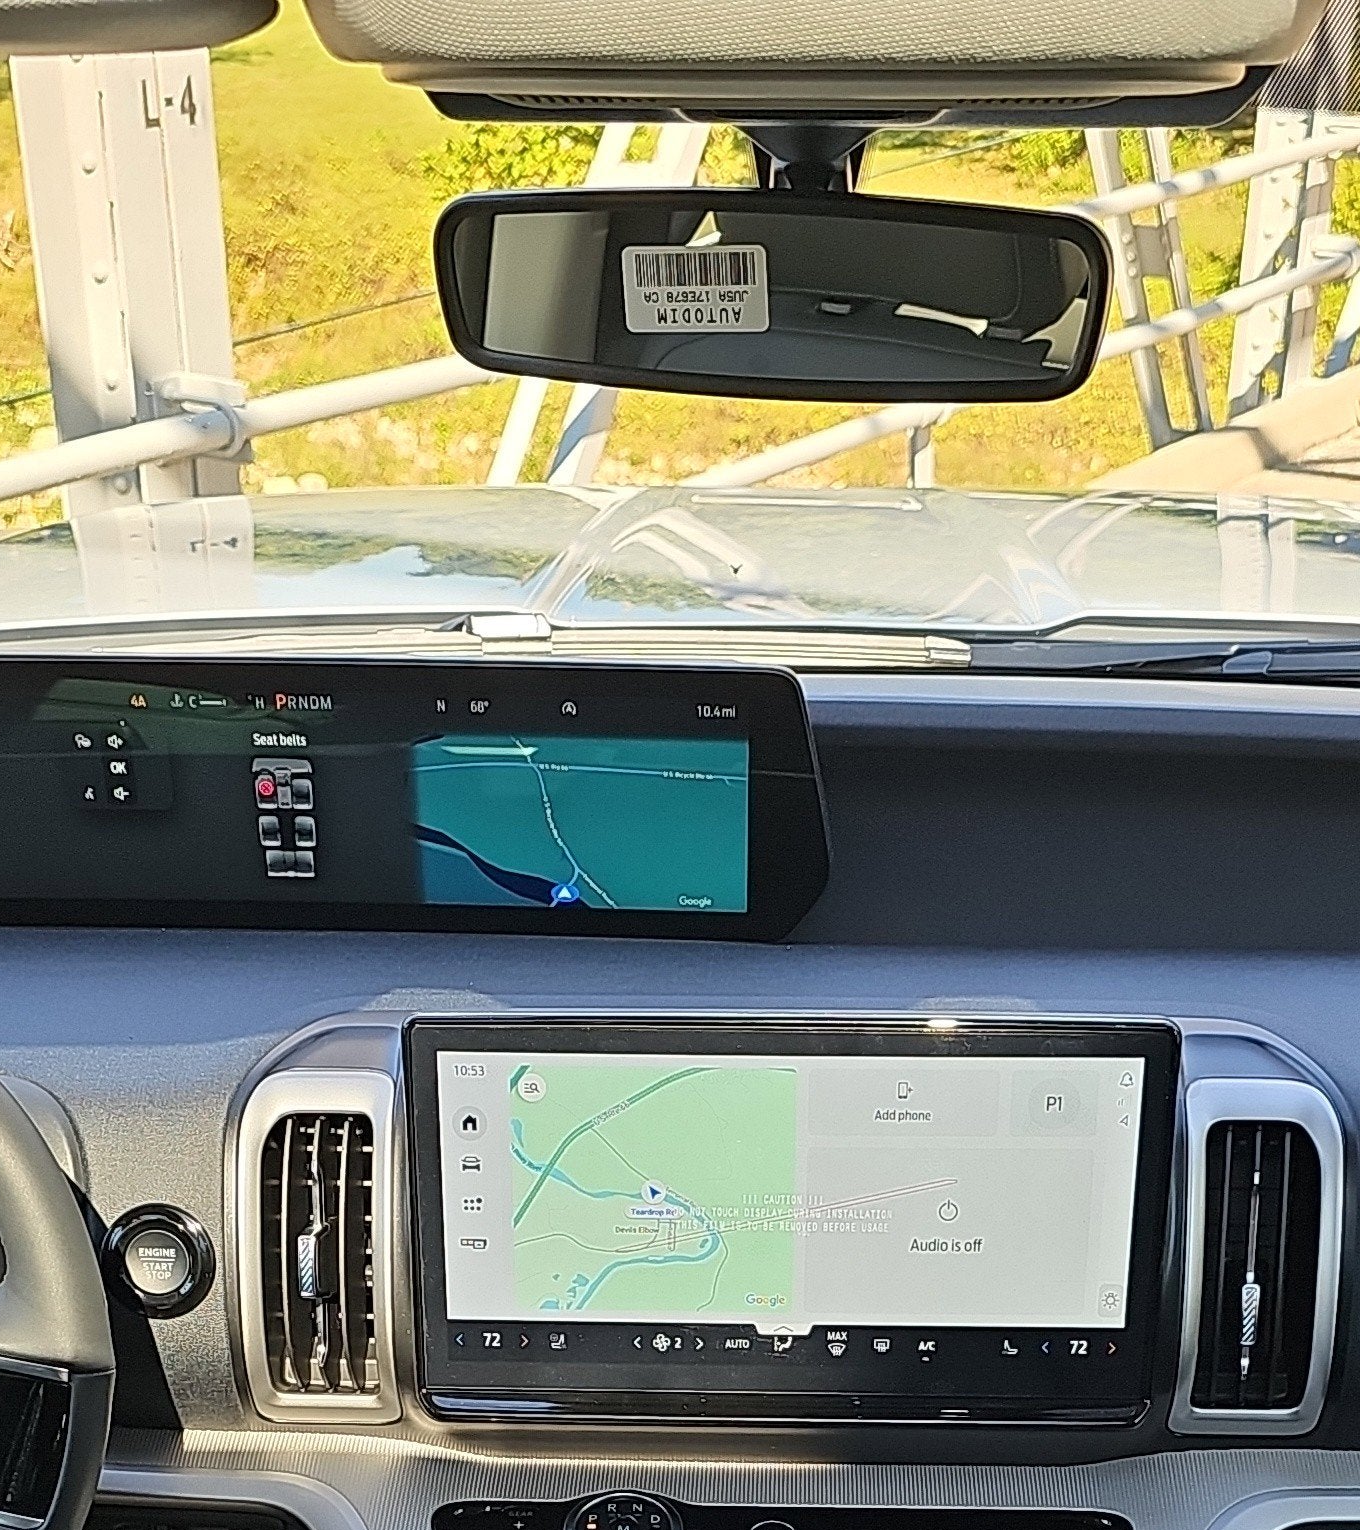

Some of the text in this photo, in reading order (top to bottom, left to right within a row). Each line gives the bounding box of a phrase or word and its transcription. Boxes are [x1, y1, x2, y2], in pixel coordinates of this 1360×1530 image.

[141, 74, 197, 129] L-4
[643, 292, 660, 304] CA
[666, 291, 710, 303] 17E678
[656, 306, 742, 325] AUTODIM
[436, 699, 446, 712] N
[252, 732, 307, 747] Seat belts
[109, 761, 128, 775] OK
[679, 895, 712, 908] Google
[453, 1065, 486, 1078] 10:53
[1045, 1096, 1063, 1112] P1
[874, 1109, 932, 1123] Add phone
[762, 1194, 804, 1206] CAUTION
[630, 1208, 665, 1217] Teardrop
[711, 1206, 739, 1218] TOUCH
[743, 1207, 782, 1219] DISPLAY
[826, 1209, 893, 1220] INSTALLATION
[615, 1226, 660, 1234] Devils Elbow
[677, 1220, 698, 1230] THIS
[762, 1221, 775, 1232] BE
[780, 1221, 818, 1232] REMOVED
[822, 1222, 856, 1233] BEFORE
[861, 1222, 889, 1233] USAGE
[909, 1238, 984, 1253] Audio is off
[138, 1247, 177, 1258] ENGINE
[142, 1262, 175, 1272] START
[145, 1270, 172, 1280] STOP
[745, 1293, 786, 1306] Google
[482, 1332, 502, 1347] 72
[826, 1330, 848, 1341] MAX
[674, 1337, 682, 1349] 2
[724, 1337, 750, 1349] AUTO
[918, 1340, 936, 1352] A/C
[1069, 1340, 1088, 1355] 72
[607, 1503, 617, 1513] R
[632, 1503, 643, 1513] N
[588, 1514, 598, 1523] P
[650, 1514, 661, 1524] D
